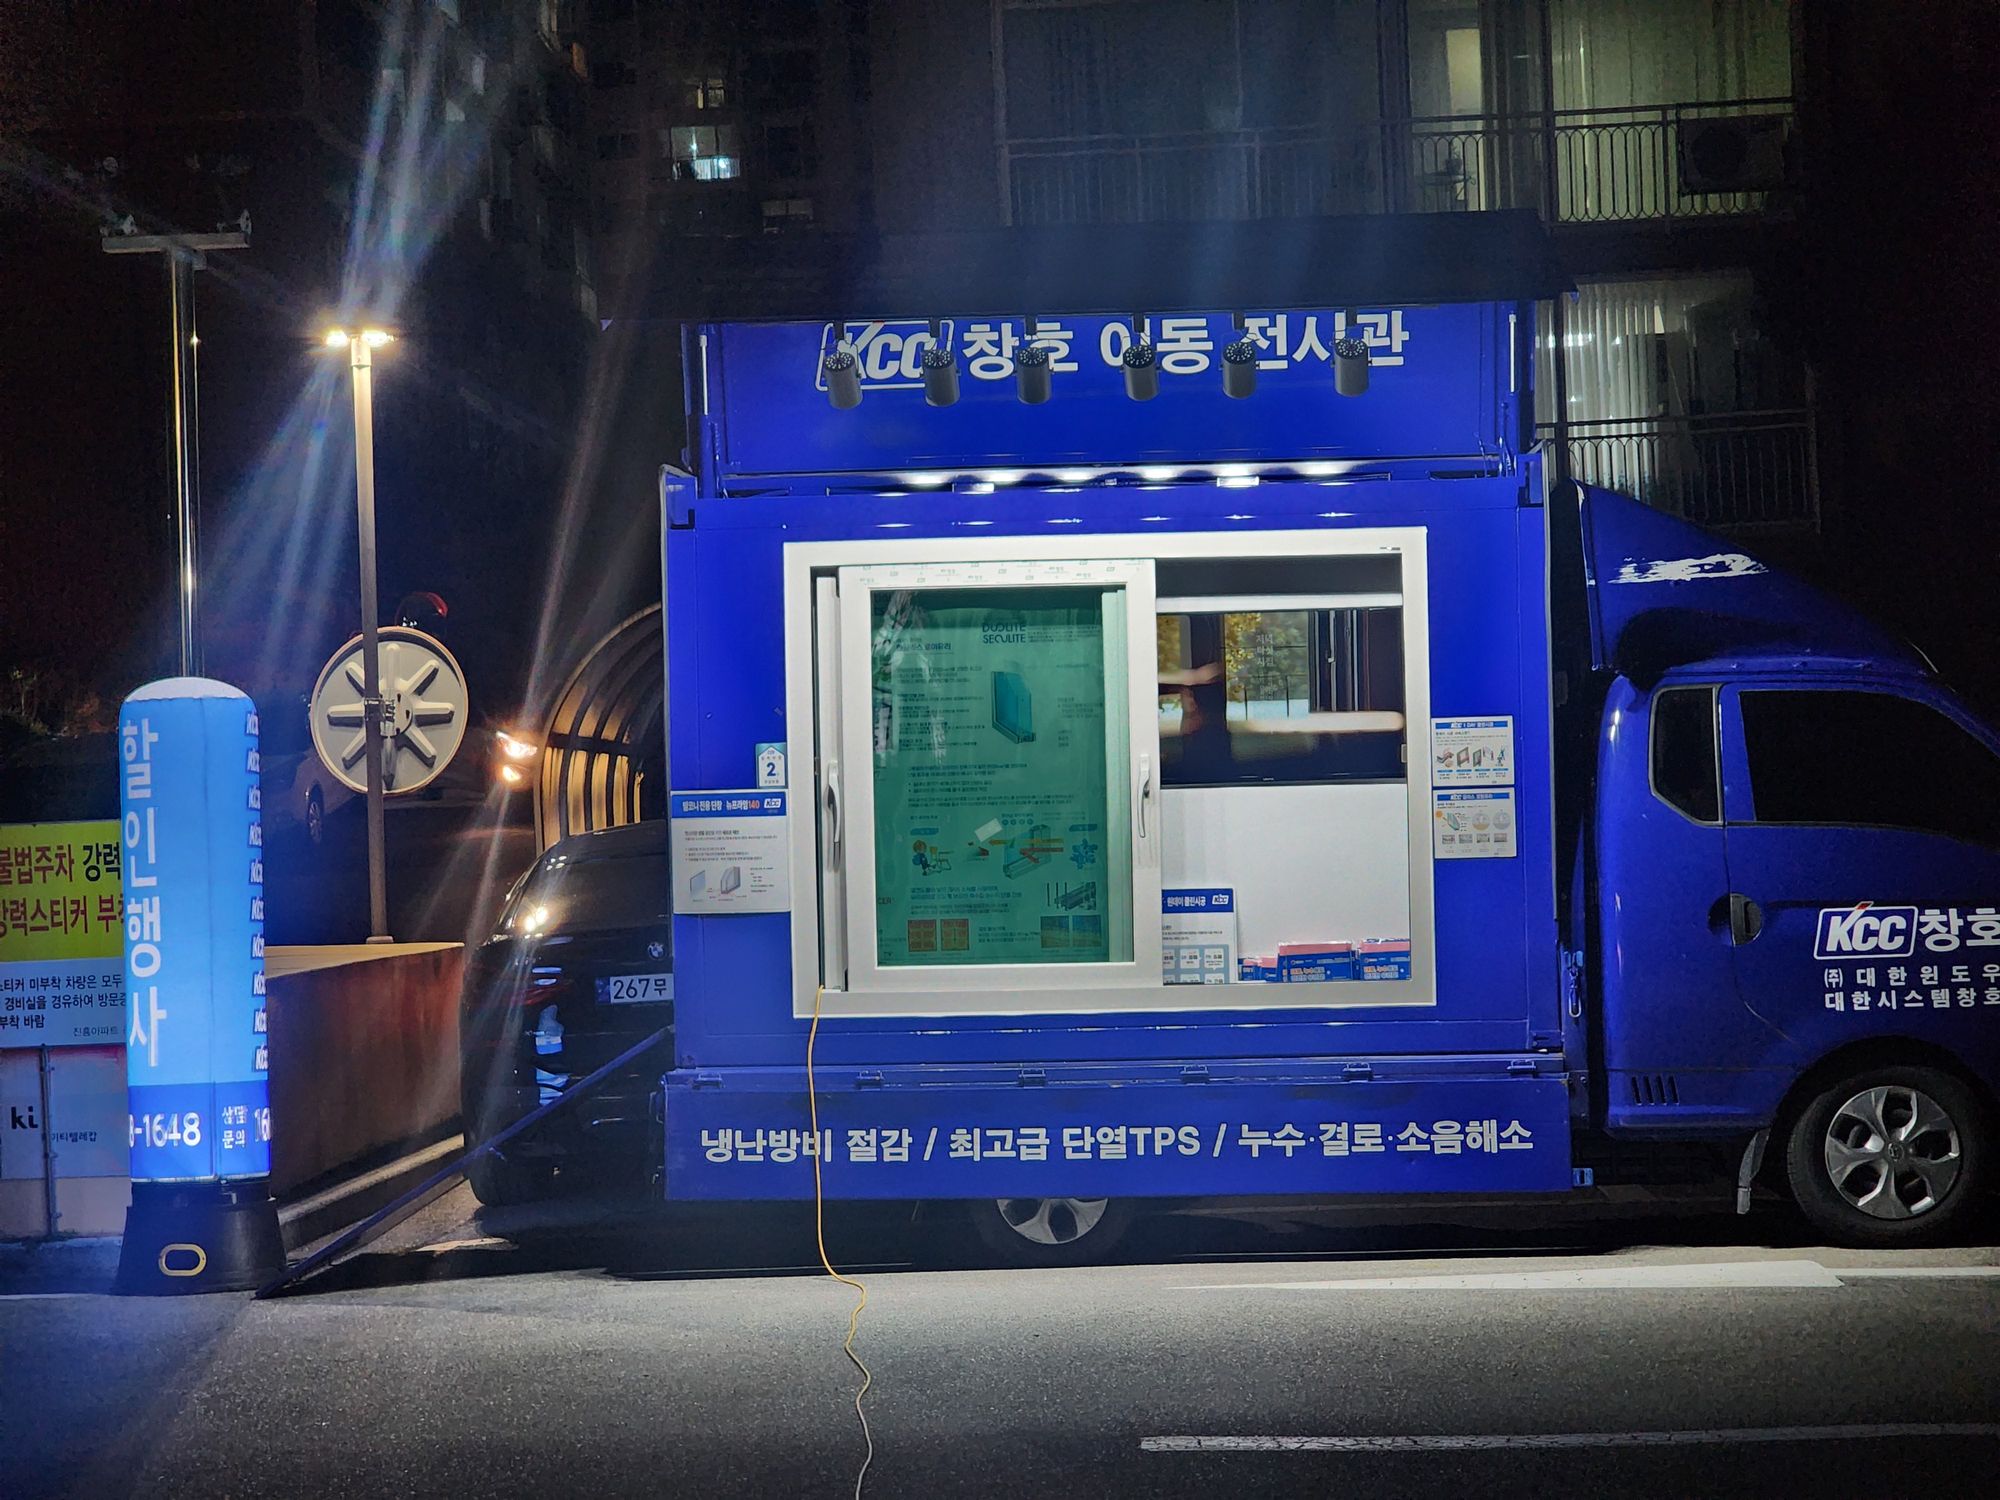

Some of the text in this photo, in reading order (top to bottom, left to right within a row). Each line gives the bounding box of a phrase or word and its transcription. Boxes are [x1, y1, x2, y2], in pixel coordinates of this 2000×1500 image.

[766, 762, 777, 777] 2
[0, 842, 121, 885] 불법주차 강력
[123, 718, 167, 1067] 할인행사
[97, 893, 124, 933] 부
[1825, 901, 2000, 953] KCC 창호
[0, 974, 122, 992] 티커 미부착 차량은 모두
[613, 977, 668, 1000] 267무
[5, 995, 47, 1011] 경비실을
[51, 994, 93, 1009] 경유하여
[24, 1014, 45, 1029] 바람
[222, 1129, 246, 1150] 문의
[701, 1128, 832, 1163] 냉난방비
[846, 1128, 913, 1163] 절감
[923, 1127, 939, 1162] /
[949, 1127, 1050, 1162] 최고급
[1062, 1125, 1201, 1160] 단열TPS
[1212, 1123, 1228, 1158] /
